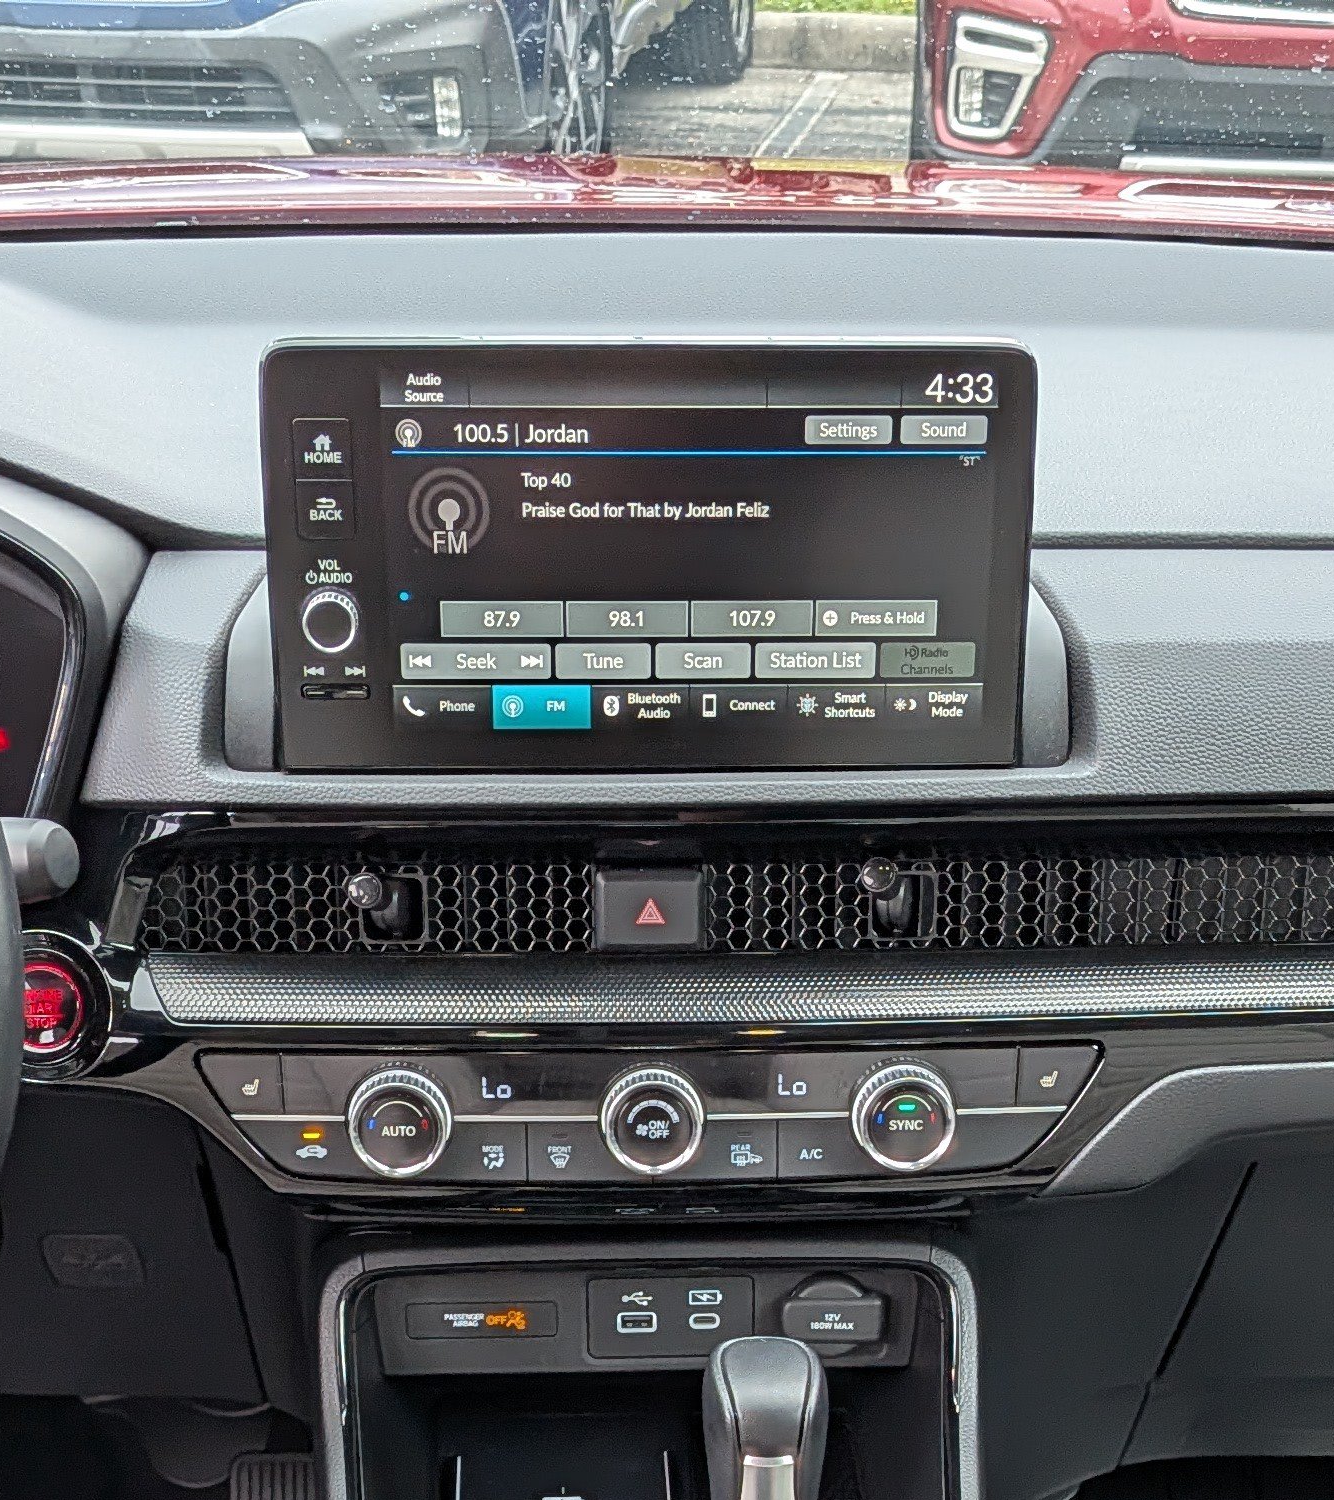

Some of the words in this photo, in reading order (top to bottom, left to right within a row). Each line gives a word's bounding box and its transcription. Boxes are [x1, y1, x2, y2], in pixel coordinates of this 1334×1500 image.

[406, 373, 442, 386] Audio
[924, 373, 994, 404] 4:33
[404, 389, 444, 403] Source
[453, 423, 509, 444] 100.5
[524, 423, 589, 444] Jordan
[819, 421, 878, 440] Settings
[921, 421, 967, 438] Sound
[304, 451, 343, 464] HOME
[521, 472, 548, 490] Top
[551, 472, 572, 488] 40
[309, 509, 343, 522] BACK
[522, 502, 566, 518] Praise
[569, 502, 599, 518] God
[603, 502, 625, 518] for
[627, 502, 661, 518] That
[664, 502, 683, 520] by
[685, 502, 733, 518] Jordan
[736, 502, 770, 518] Feliz
[433, 531, 468, 554] FM
[318, 559, 341, 571] VOL
[319, 572, 353, 584] AUDIO
[483, 610, 521, 628] 87.9
[608, 610, 645, 628] 98.1
[729, 610, 776, 628] 107.9
[850, 612, 882, 625] Press
[884, 612, 894, 625] &
[896, 611, 925, 625] Hold
[920, 646, 949, 659] Radio
[455, 652, 497, 670] Seek
[583, 652, 624, 669] Tune
[683, 652, 723, 669] Scan
[770, 652, 828, 669] Station
[832, 651, 862, 669] List
[900, 663, 954, 676] Channels
[627, 692, 681, 705] Bluetooth
[834, 692, 867, 704] Smart
[928, 691, 969, 706] Display
[439, 700, 476, 713] Phone
[546, 700, 566, 713] FM
[729, 699, 776, 712] Connect
[931, 706, 964, 718] Mode
[637, 706, 671, 719] Audio
[824, 706, 875, 719] Shortcuts
[26, 1017, 58, 1029] STOP
[381, 1125, 416, 1137] AUTO
[649, 1121, 670, 1130] ON/
[889, 1118, 924, 1132] SYNC
[649, 1130, 669, 1139] OFF
[482, 1145, 504, 1153] MODE
[548, 1145, 572, 1153] FRONT
[799, 1149, 823, 1160] A/C
[443, 1313, 485, 1321] PASSENGER
[486, 1315, 507, 1326] OFF
[824, 1313, 841, 1321] 12V
[833, 1321, 855, 1330] MAX
